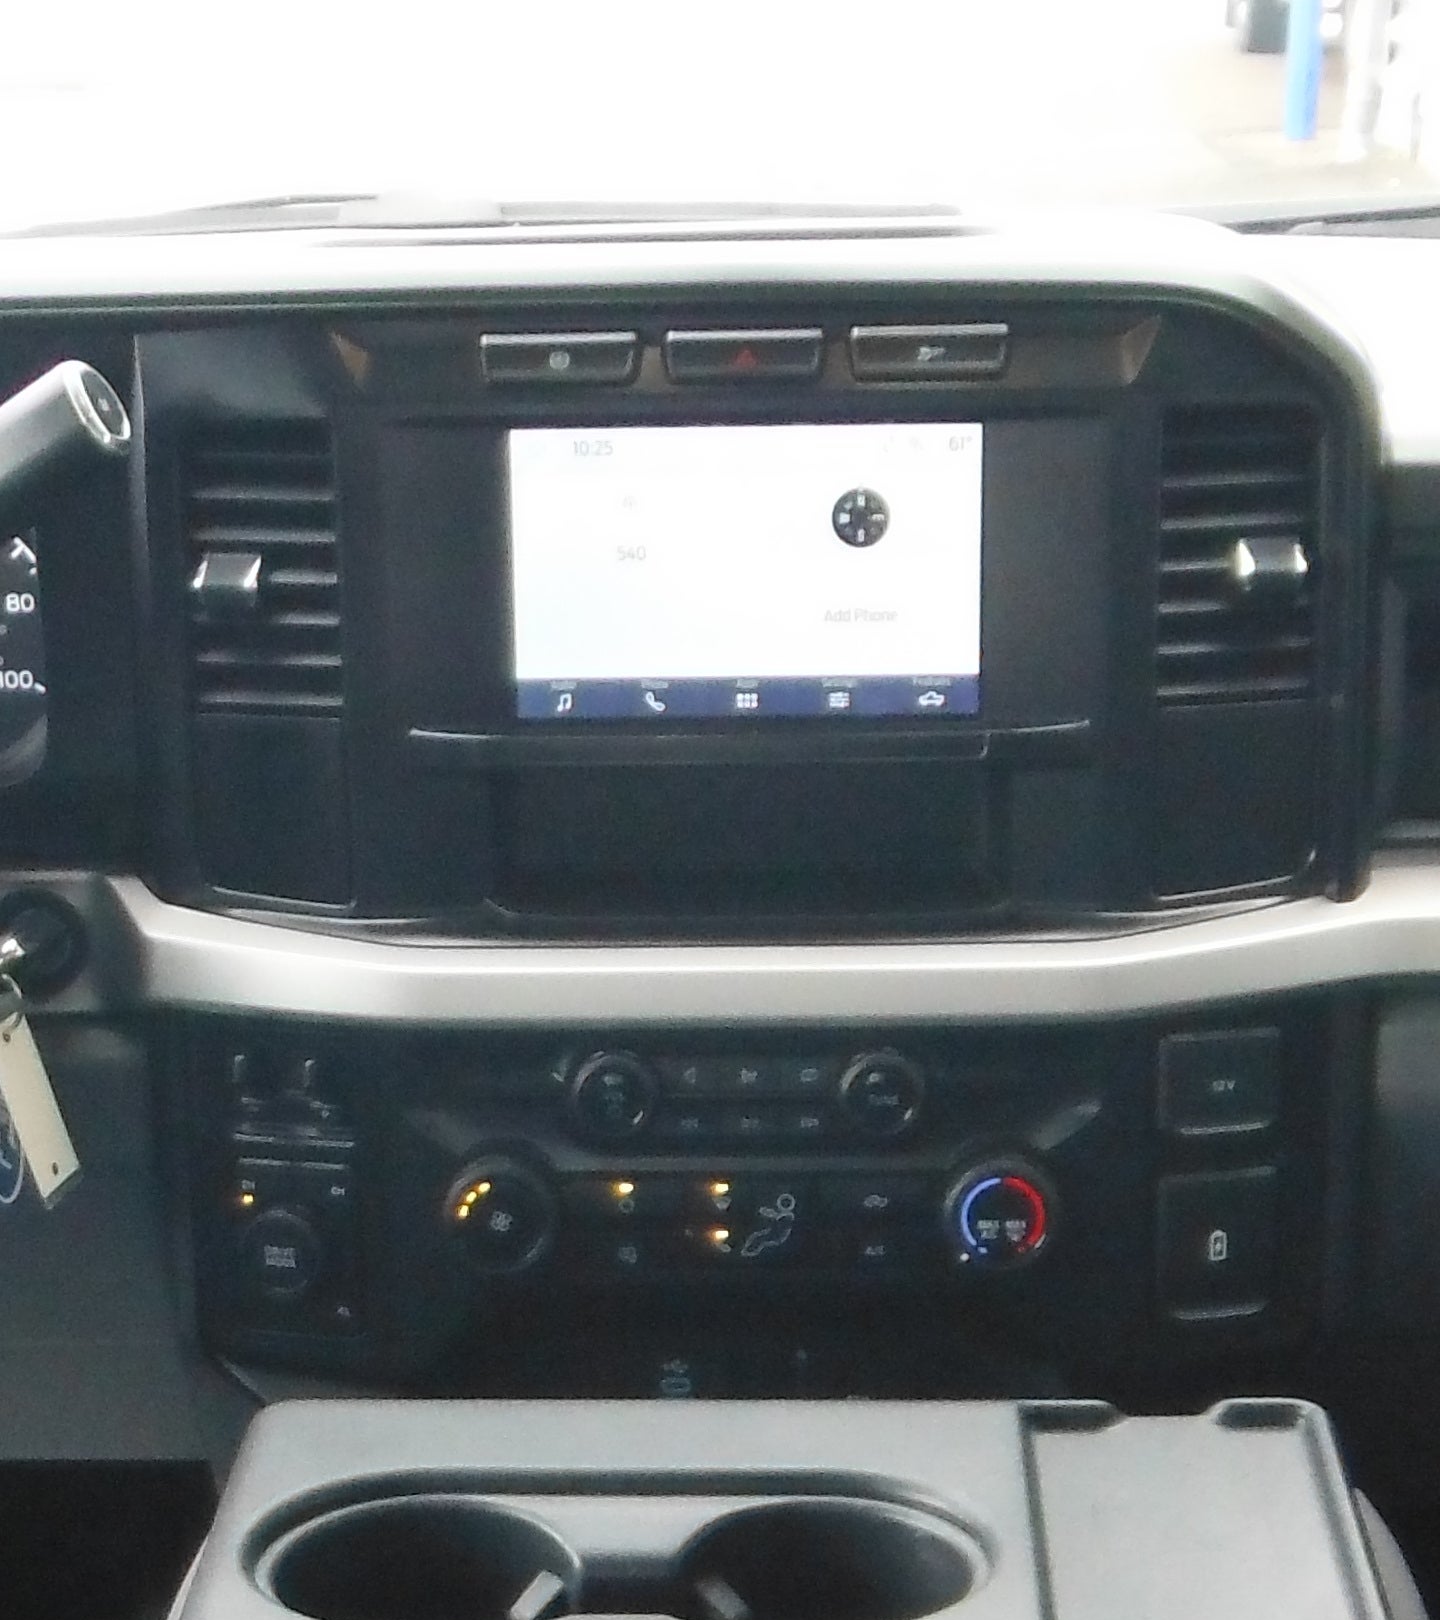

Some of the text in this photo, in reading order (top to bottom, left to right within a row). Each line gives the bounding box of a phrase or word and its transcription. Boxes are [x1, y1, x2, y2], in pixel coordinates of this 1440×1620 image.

[572, 439, 614, 457] 10:25
[5, 592, 36, 614] 80
[824, 608, 851, 622] Add
